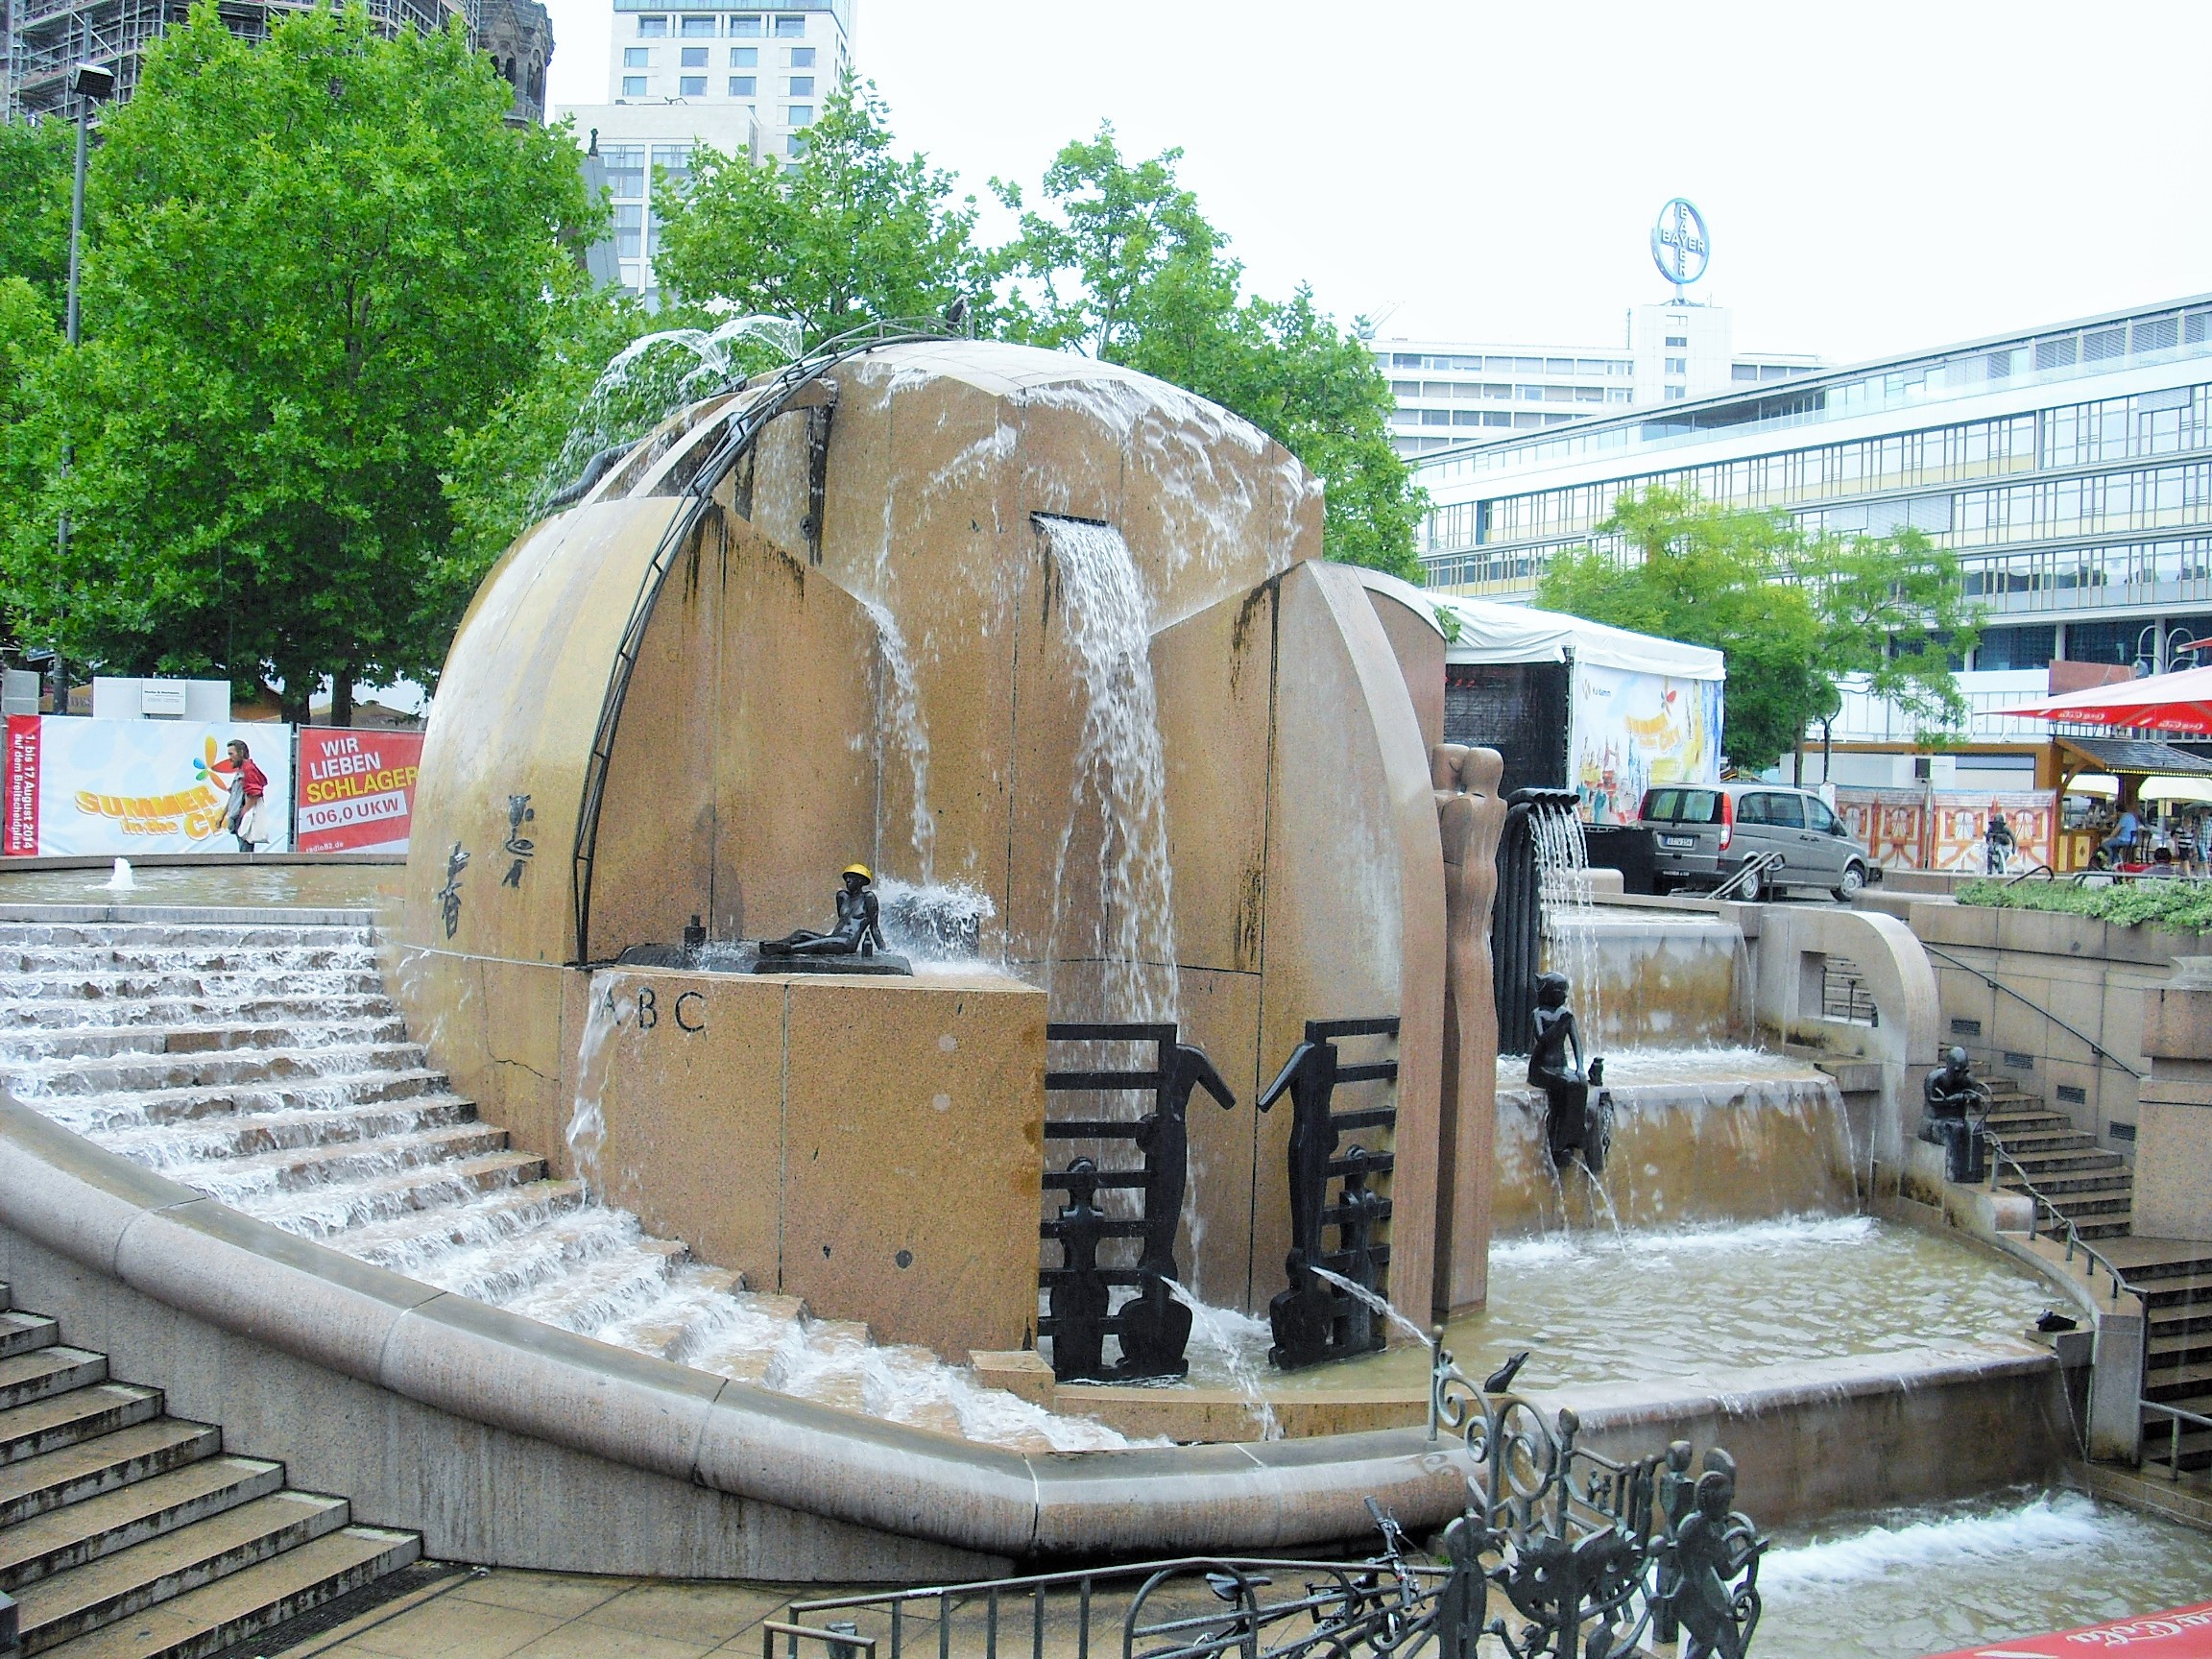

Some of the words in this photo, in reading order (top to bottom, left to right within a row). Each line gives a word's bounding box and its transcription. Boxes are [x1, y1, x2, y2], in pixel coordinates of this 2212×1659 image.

[1661, 228, 1705, 253] BAYER
[14, 733, 24, 750] auf
[24, 746, 36, 763] bis
[321, 736, 360, 757] WIR
[13, 751, 24, 773] dem
[310, 751, 382, 781] LIEBEN
[306, 765, 419, 804] SCHLAGER
[12, 775, 23, 851] Breitscheidplatz
[21, 781, 36, 821] August
[75, 784, 220, 820] SUMMER
[306, 806, 353, 827] 106,0
[356, 797, 399, 818] UKW
[22, 823, 35, 849] 2014
[144, 817, 179, 835] the
